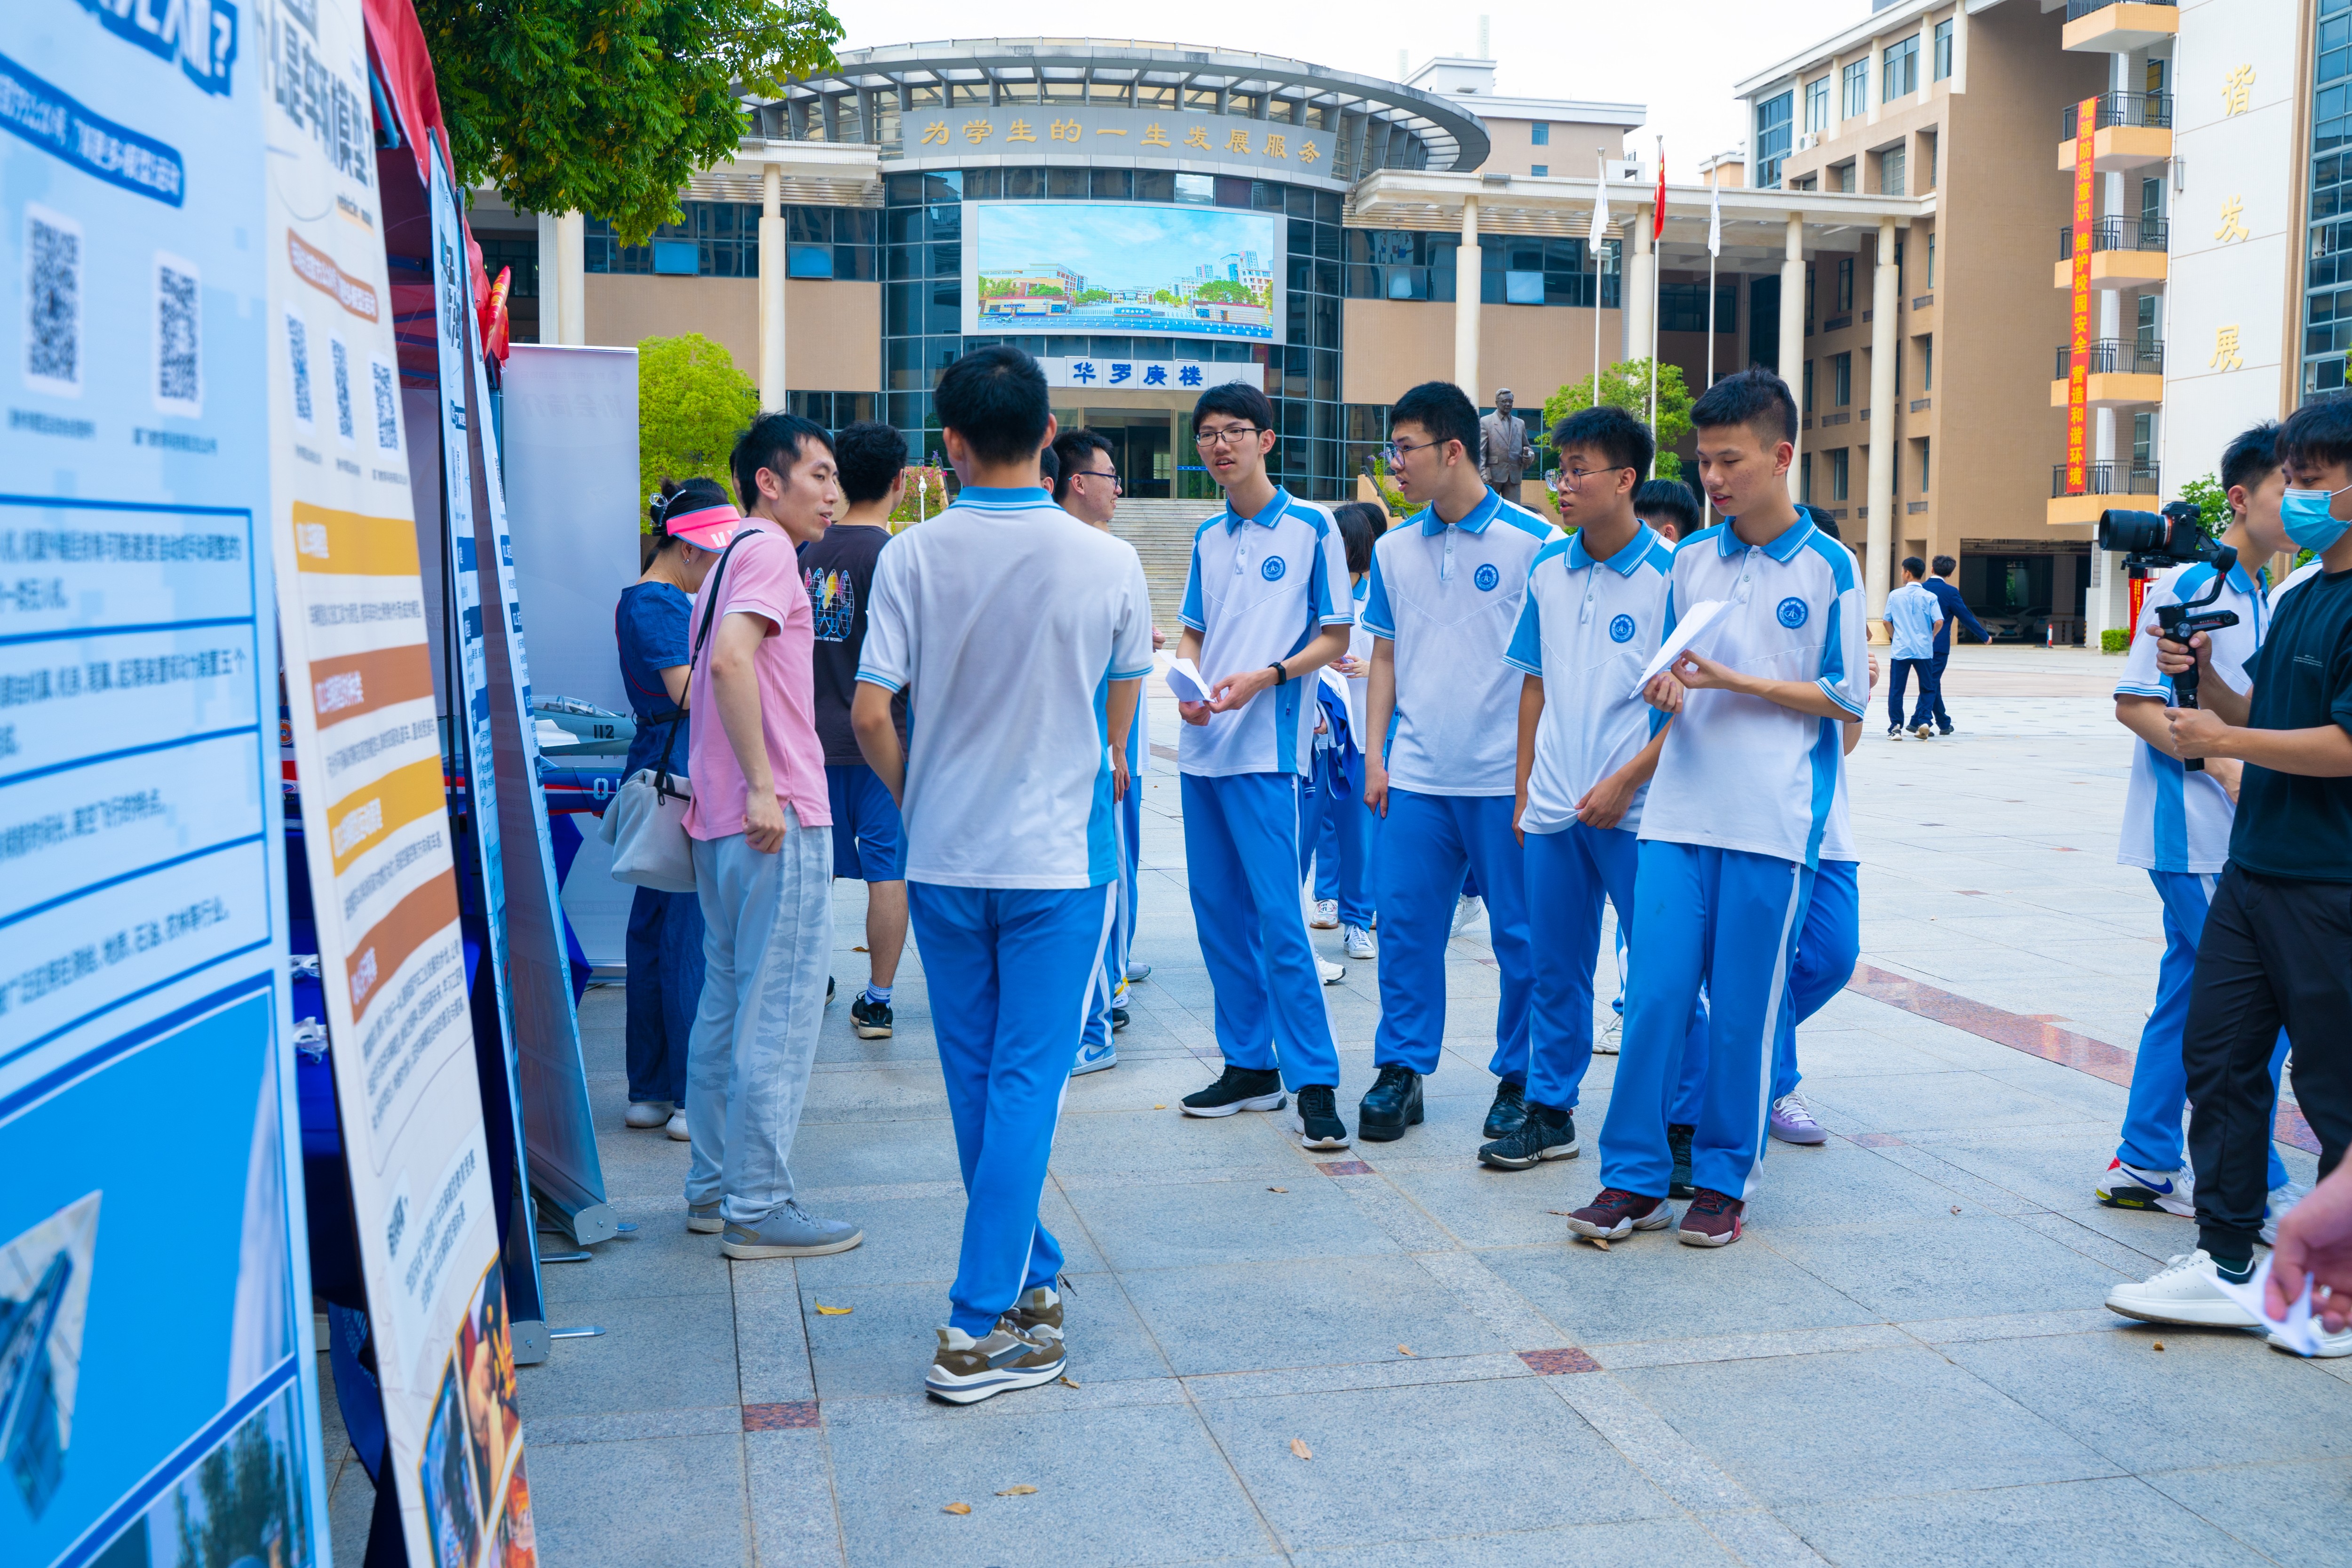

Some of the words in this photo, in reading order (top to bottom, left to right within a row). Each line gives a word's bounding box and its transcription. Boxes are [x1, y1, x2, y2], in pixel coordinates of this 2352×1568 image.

[921, 118, 1321, 164] 为学生的一生发展服务
[2076, 98, 2095, 223] 增强防范意识
[2074, 232, 2090, 355] 维护校园安全
[1073, 361, 1203, 386] 华罗庚楼
[2068, 364, 2085, 486] 营造和谐环境
[594, 724, 614, 739] 112
